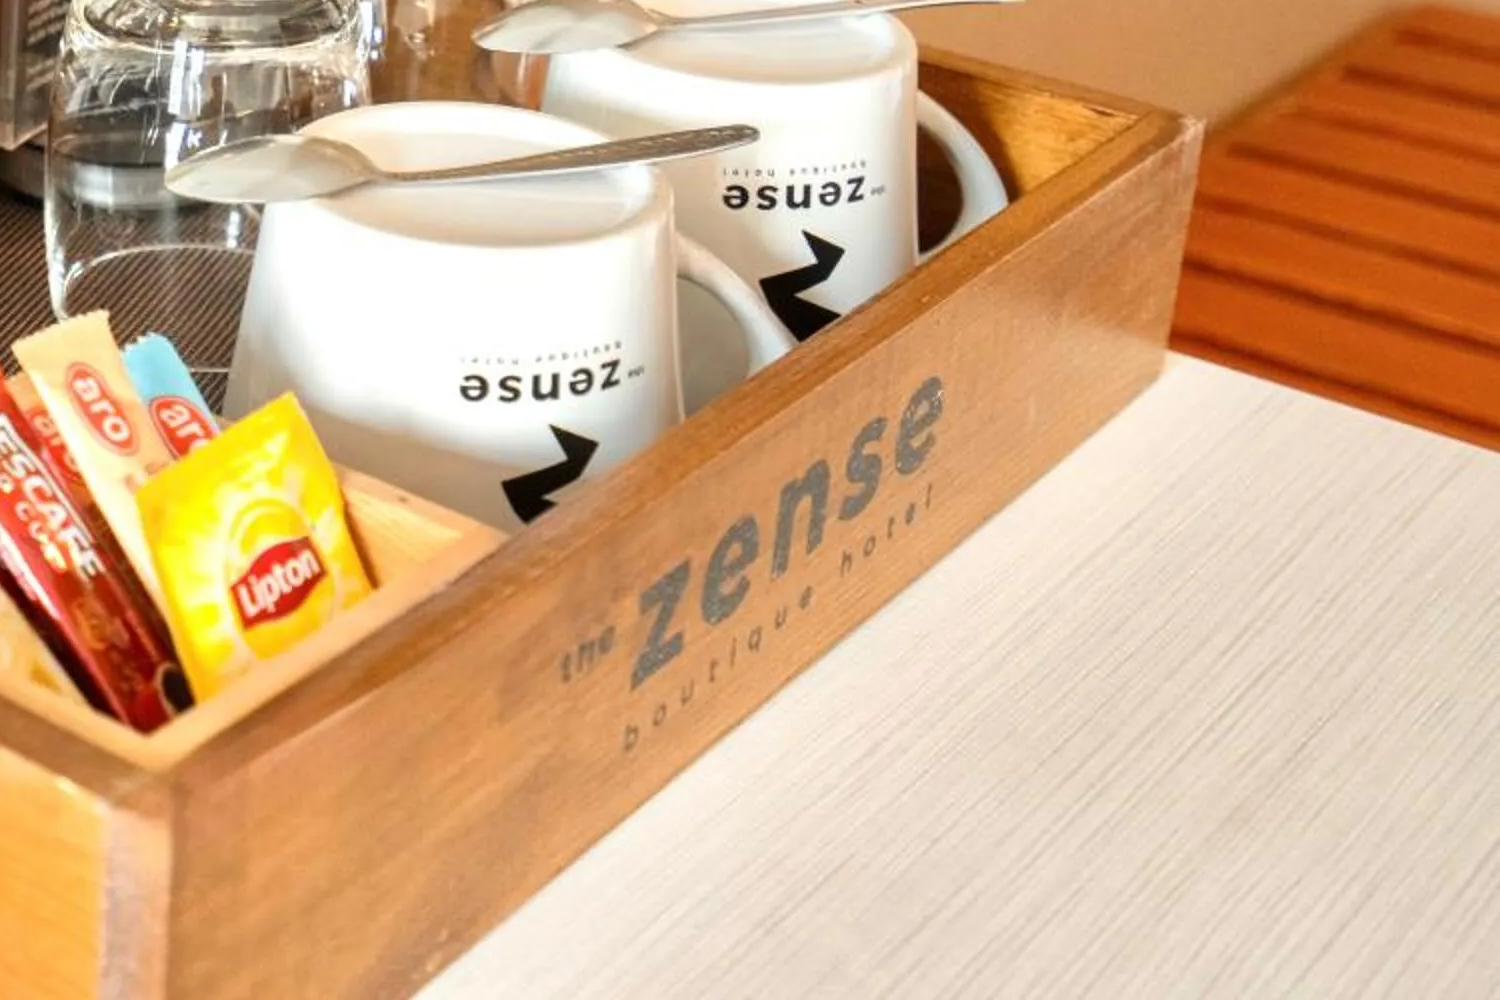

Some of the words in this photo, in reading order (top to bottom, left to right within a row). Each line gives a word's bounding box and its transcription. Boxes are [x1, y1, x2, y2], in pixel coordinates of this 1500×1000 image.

[722, 176, 866, 211] zense
[73, 378, 131, 441] aro
[459, 358, 622, 403] zense
[561, 623, 617, 684] the
[630, 375, 946, 692] zense
[237, 549, 321, 618] Lipton
[623, 583, 814, 753] boutique
[839, 482, 935, 578] hotel
